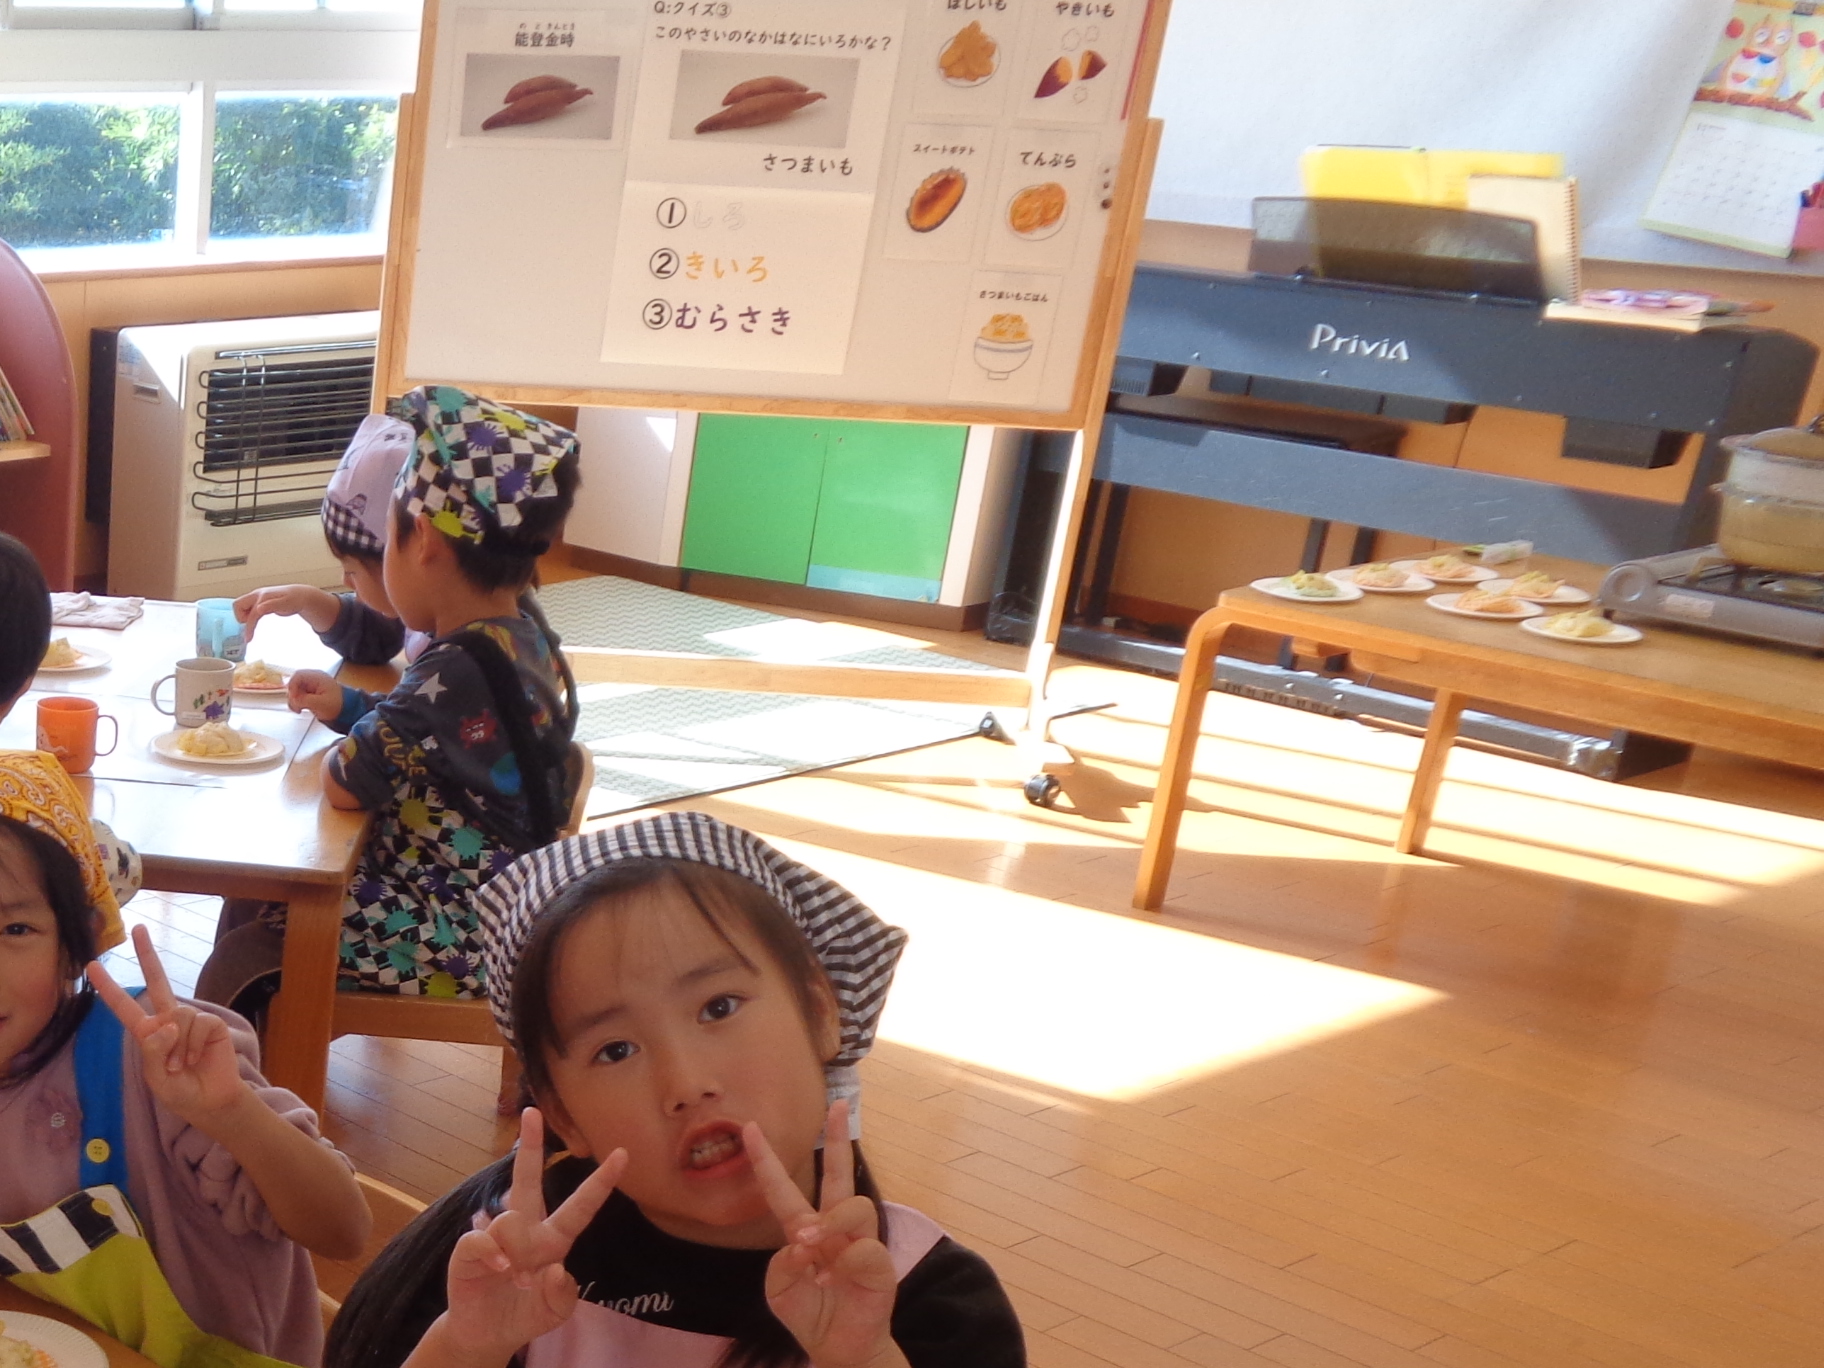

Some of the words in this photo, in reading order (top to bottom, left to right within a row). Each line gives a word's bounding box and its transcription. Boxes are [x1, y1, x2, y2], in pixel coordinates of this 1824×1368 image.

[515, 31, 574, 47] 能登金時
[763, 153, 853, 176] さつまいも
